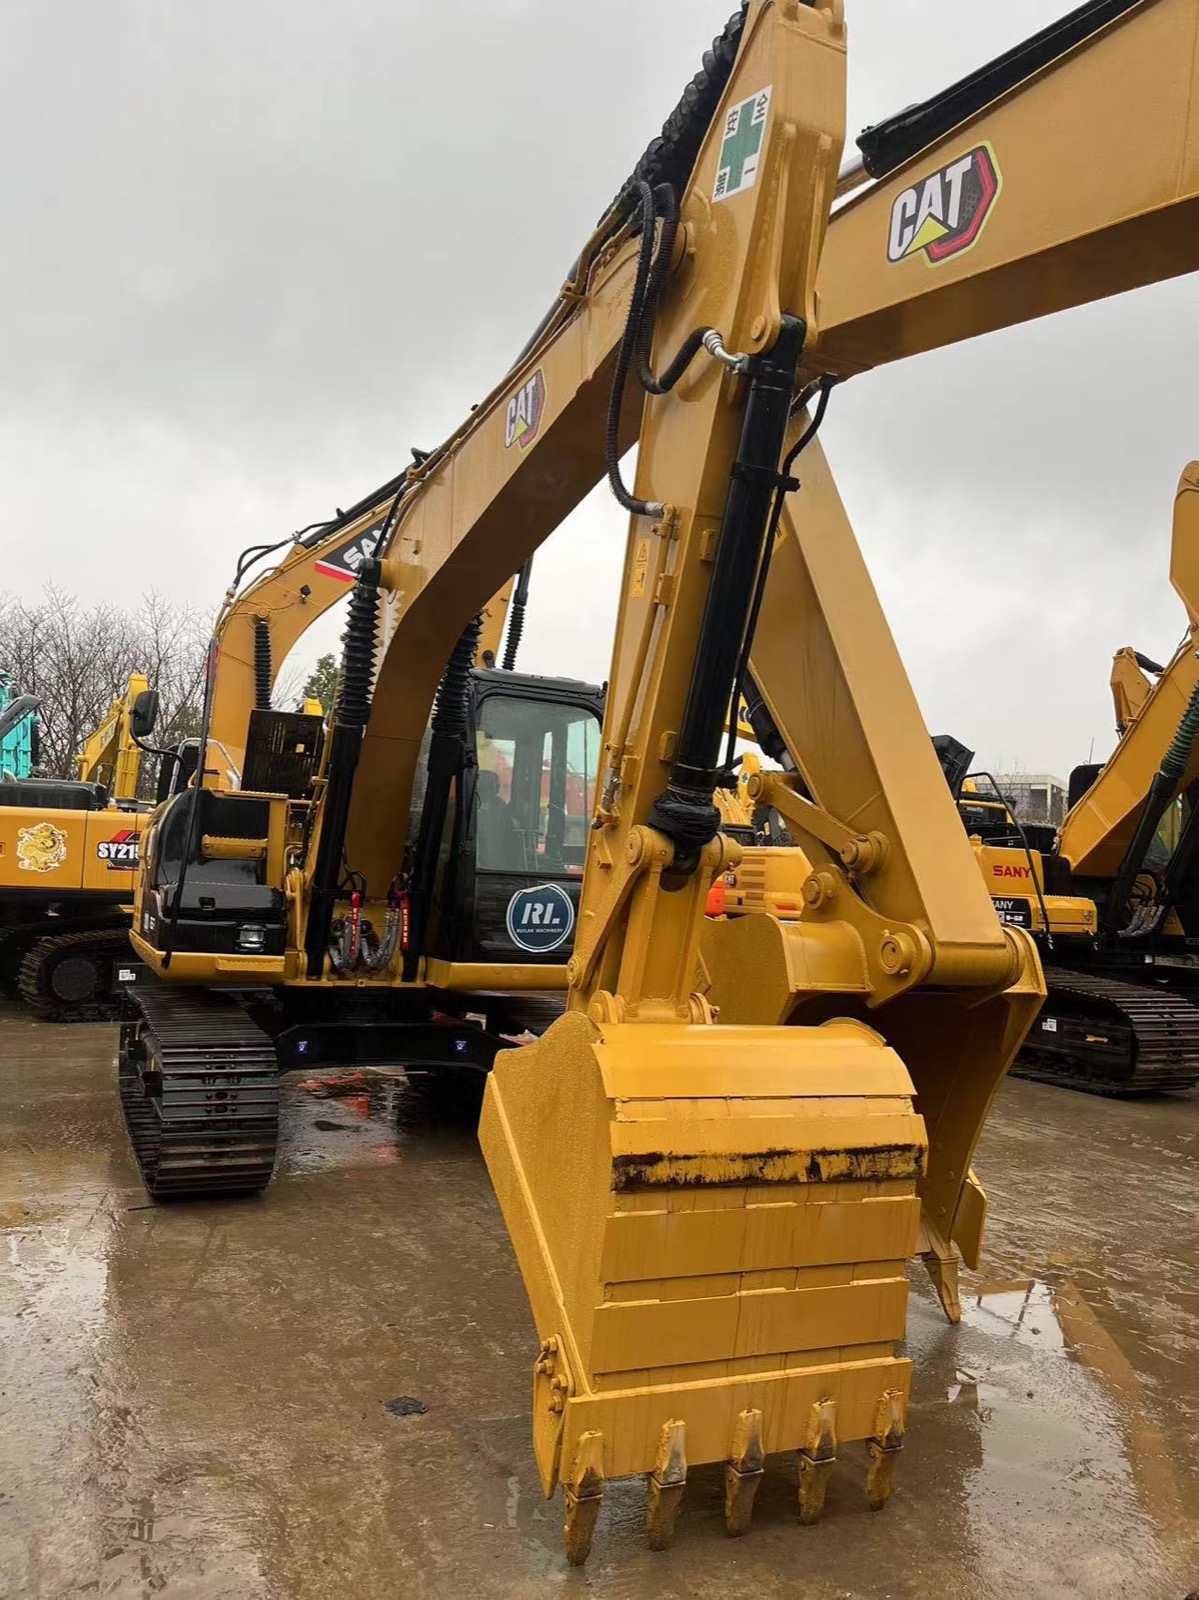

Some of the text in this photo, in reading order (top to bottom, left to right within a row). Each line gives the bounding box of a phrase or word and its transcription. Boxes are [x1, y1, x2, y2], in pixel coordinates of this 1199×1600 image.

[888, 155, 972, 260] CAT
[504, 375, 537, 448] CAT
[992, 865, 1031, 878] SANY
[521, 903, 560, 925] RL
